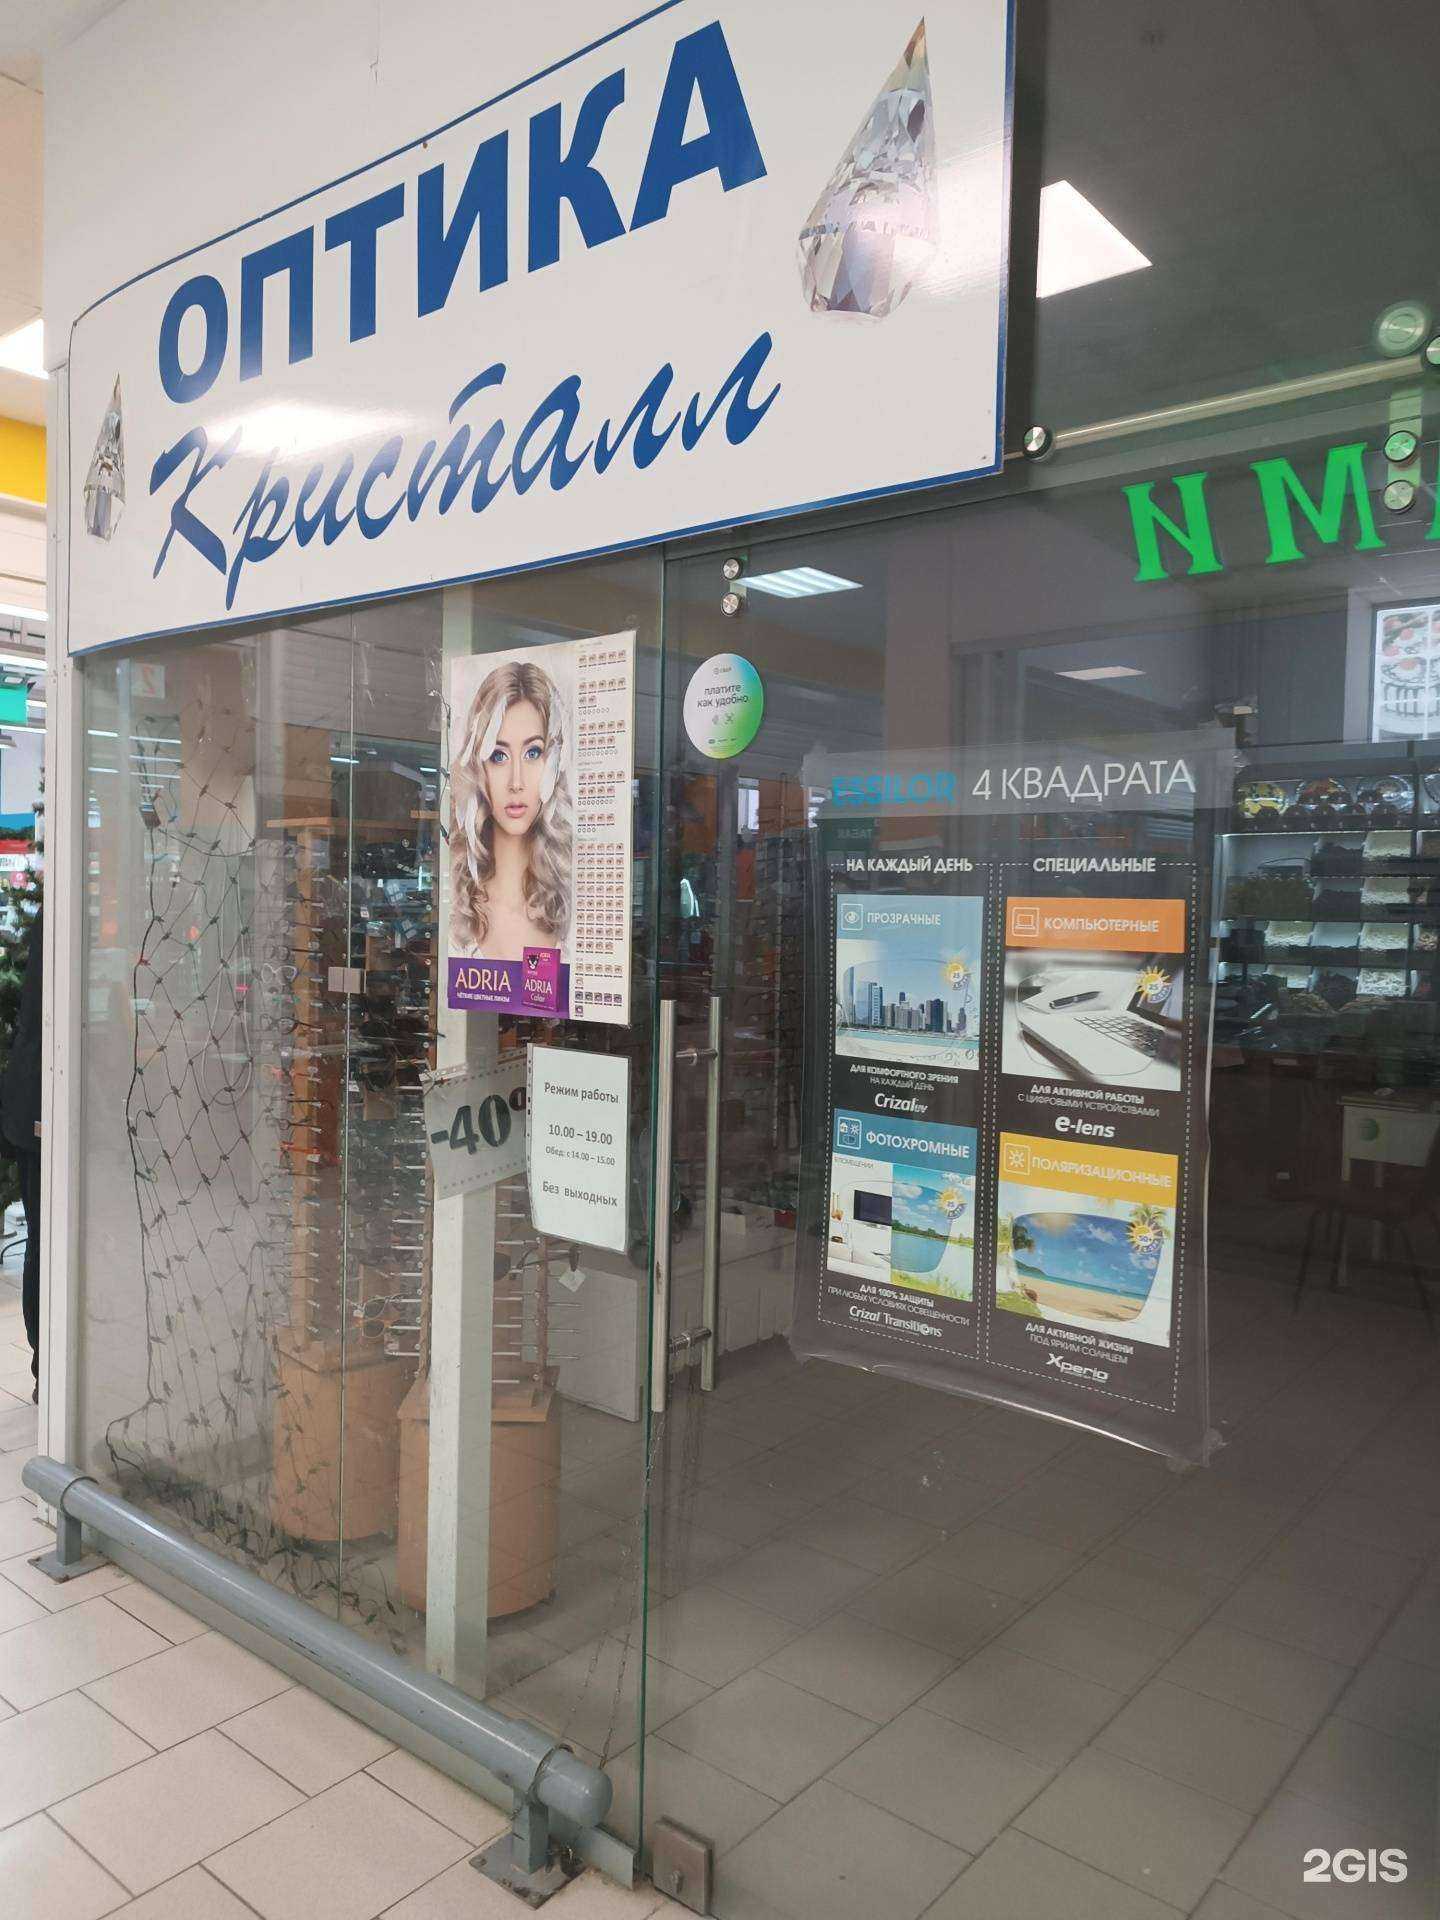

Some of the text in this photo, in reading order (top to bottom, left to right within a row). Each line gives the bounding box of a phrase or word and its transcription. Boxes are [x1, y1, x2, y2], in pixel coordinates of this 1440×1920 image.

[158, 19, 768, 405] ОПТИКА
[149, 331, 780, 612] Кристалл
[697, 694, 749, 708] как удобно
[704, 684, 742, 696] платите
[832, 759, 1197, 805] ESSILOR 4 КВАДРАТА
[846, 855, 973, 874] НА КАЖДЫЙ ДЕНЬ
[1033, 858, 1156, 874] СПЕЦИАЛЬНЫЕ
[867, 911, 941, 926] ПРОЗРАЧНЫЕ
[1044, 917, 1160, 933] КОМПЬЮТЕРНЫЕ
[455, 967, 512, 993] ADRIA
[524, 979, 553, 995] ADRIA
[543, 1081, 619, 1104] Режим работы
[1030, 1084, 1145, 1105] ДЛЯ АКТИВНОЙ РАБОТЫ
[1017, 1093, 1160, 1117] С ЦИФРОВЫМИ УСТРОЙСТВАМИ
[548, 1124, 576, 1139] 10.00
[585, 1130, 613, 1145] 19.00
[1055, 1116, 1115, 1138] e-lens
[866, 1131, 970, 1159] ФОТОХРОМНЫЕ
[597, 1155, 616, 1166] 15.00
[1032, 1156, 1173, 1188] ПОЛЯРИЗАЦИОННЫЕ
[542, 1181, 618, 1207] Без выходных
[859, 1284, 877, 1295] ДЛЯ
[899, 1293, 934, 1307] ЗАЩИТЫ
[849, 1305, 881, 1323] Crizal
[1025, 1322, 1134, 1355] ДЛЯ АКТИВНОЙ ЖИЗНИ
[1030, 1333, 1128, 1365] ПОД ЯРКИМ СОЛНЦЕМ
